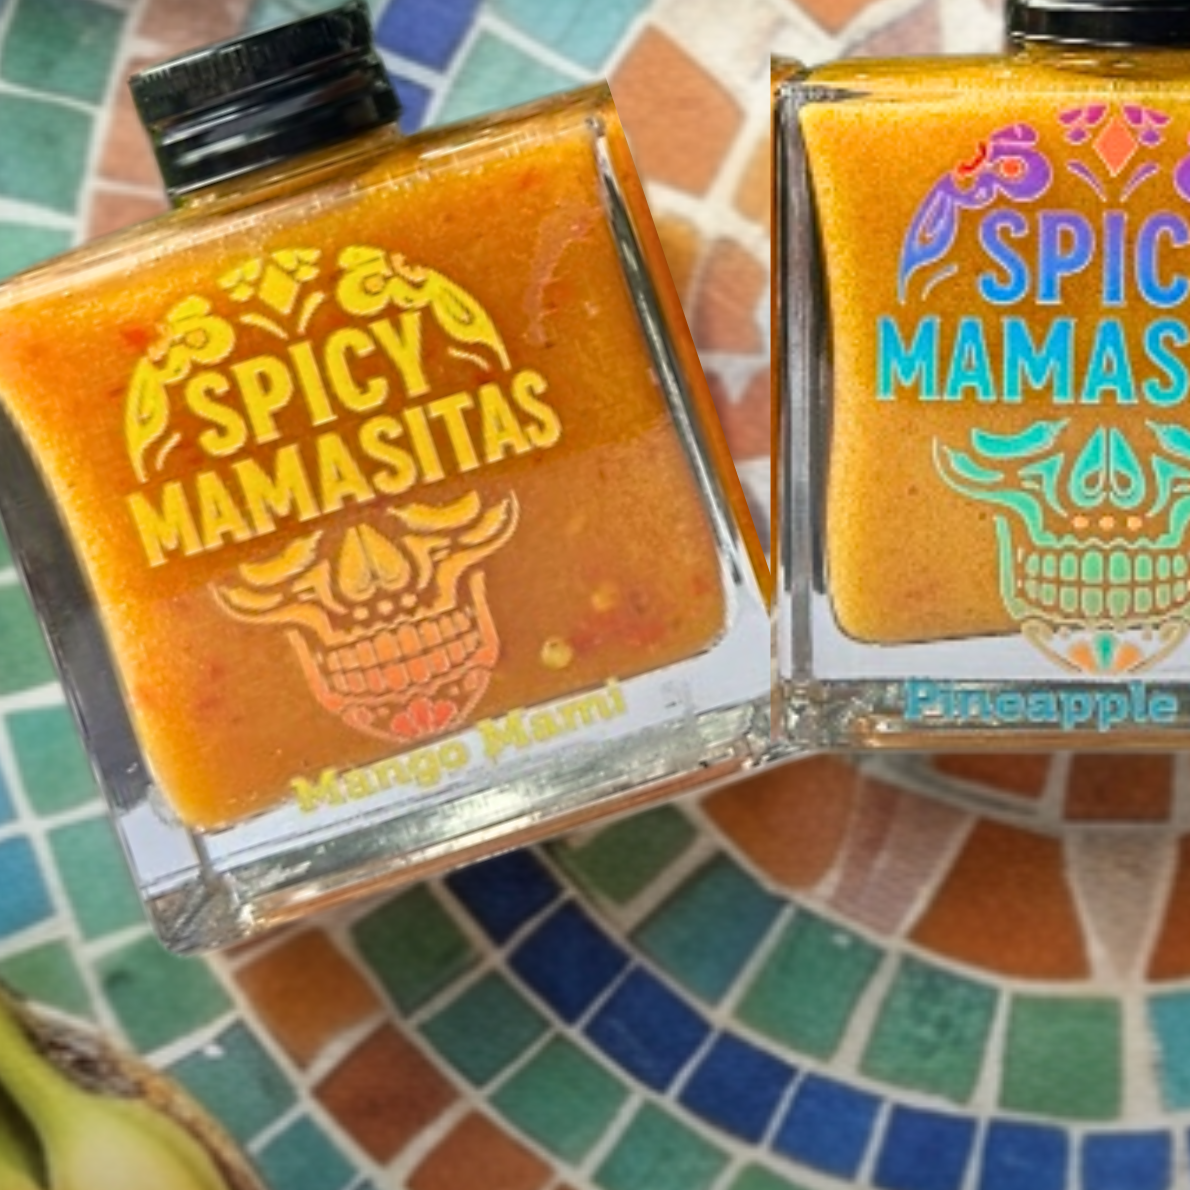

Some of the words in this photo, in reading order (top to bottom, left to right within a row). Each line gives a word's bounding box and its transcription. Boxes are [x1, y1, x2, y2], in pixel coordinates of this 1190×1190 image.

[184, 311, 434, 457] SPICY
[127, 369, 562, 568] MAMASITAS
[292, 741, 468, 812] Mango
[477, 678, 628, 760] Mami
[903, 677, 1177, 732] Pineapple
